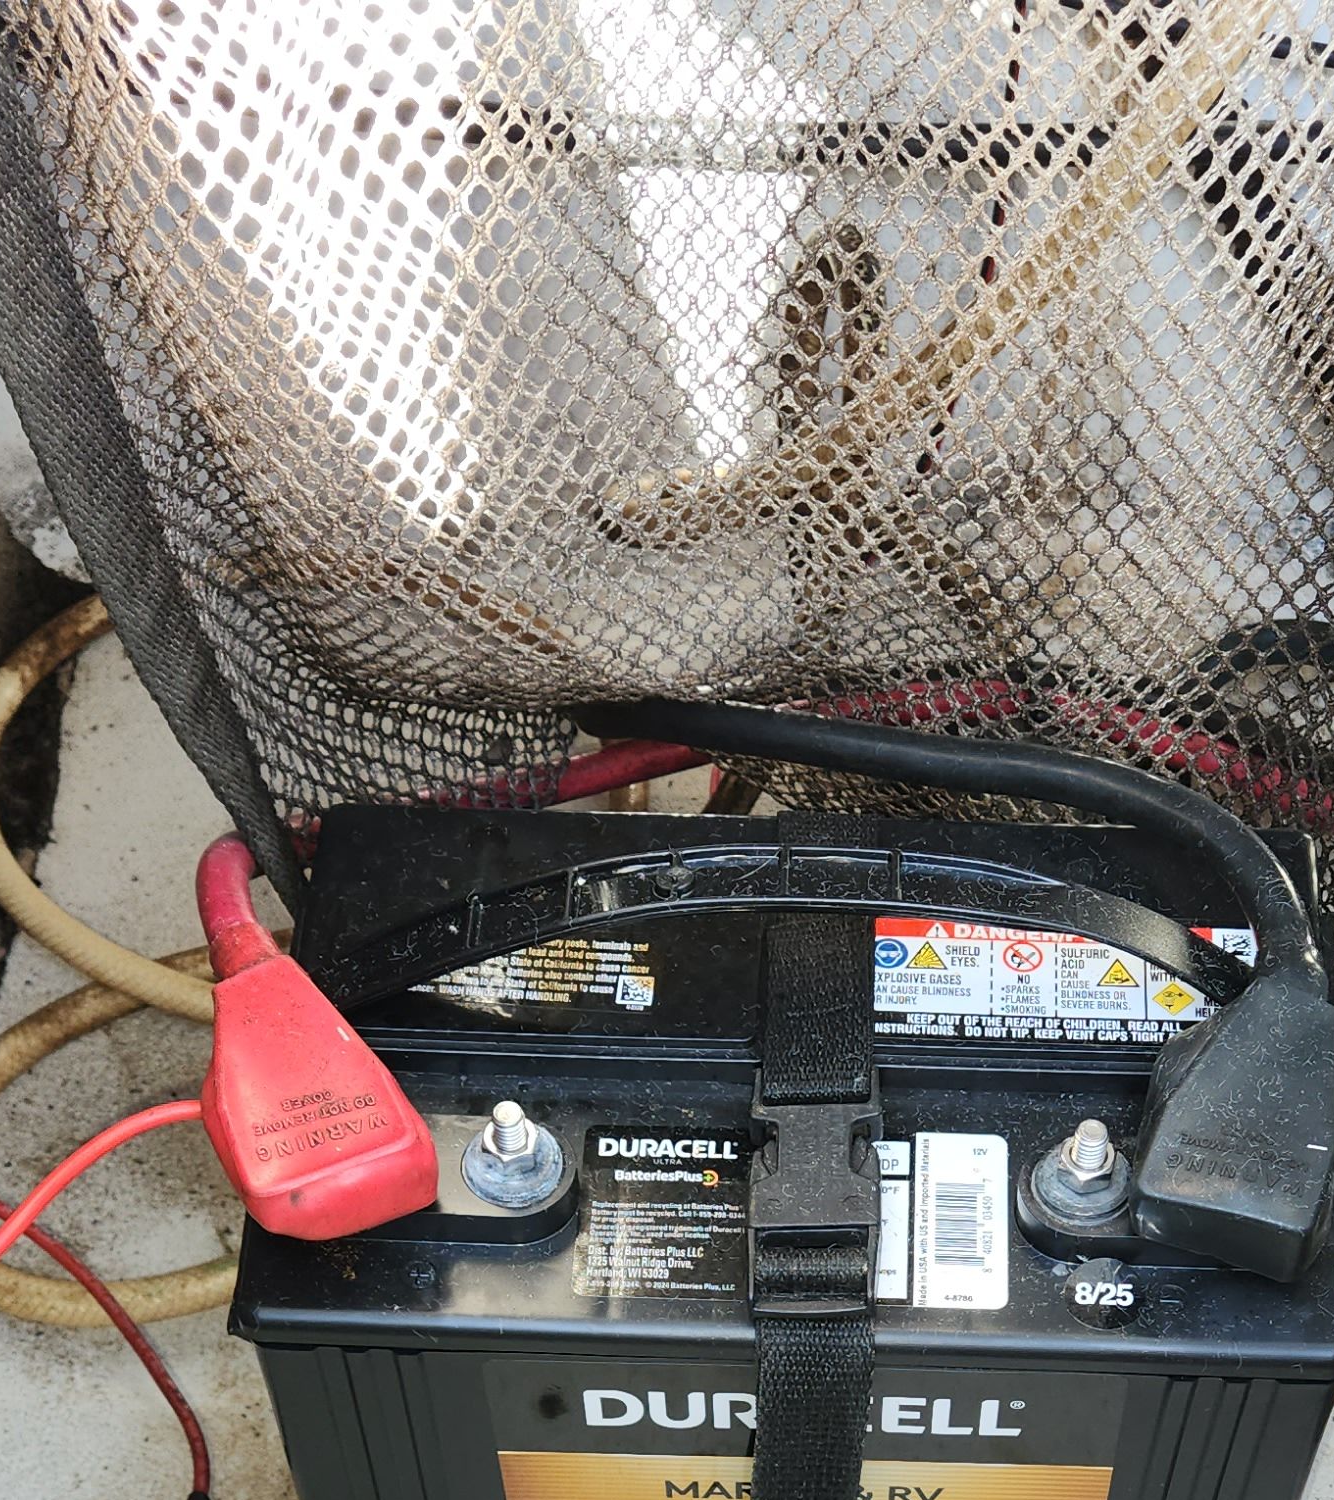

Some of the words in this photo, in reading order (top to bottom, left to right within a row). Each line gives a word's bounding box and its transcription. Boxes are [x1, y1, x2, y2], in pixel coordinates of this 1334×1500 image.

[945, 945, 980, 956] SHIELD
[1061, 948, 1110, 959] SULFURIC
[509, 956, 532, 967] State
[533, 958, 542, 967] of
[544, 958, 584, 970] California
[596, 965, 620, 973] cause
[622, 965, 650, 974] cancer
[951, 957, 979, 967] EYES.
[1061, 960, 1085, 969] ACID
[929, 974, 962, 985] GASES
[1017, 974, 1031, 984] NO
[1061, 970, 1078, 979] CAN
[875, 985, 887, 993] AN
[891, 986, 919, 995] CAUSE
[922, 987, 971, 997] BLINDNESS
[1061, 980, 1090, 989] CAUSE
[439, 984, 464, 996] WASH
[497, 987, 524, 999] AFTER
[526, 990, 571, 1003] HANDLING.
[875, 994, 882, 1004] R
[1061, 990, 1111, 999] BLINDNESS
[1113, 991, 1126, 1000] OR
[1061, 1000, 1095, 1009] SEVERE
[1097, 1001, 1131, 1010] BURNS.
[907, 1013, 936, 1024] KEEP
[937, 1015, 961, 1025] OUT
[963, 1015, 980, 1026] OF
[980, 1016, 1002, 1026] THE
[1005, 1017, 1042, 1028] REACH
[1045, 1019, 1061, 1029] OF
[1063, 1019, 1124, 1031] CHILDREN.
[1128, 1021, 1159, 1031] READ
[1161, 1021, 1182, 1032] ALL
[875, 1023, 958, 1036] NSTRUCTIONS.
[964, 1026, 981, 1037] DO
[985, 1026, 1008, 1037] NOT
[1010, 1028, 1031, 1038] TIP.
[1034, 1029, 1063, 1039] KEEP
[1065, 1030, 1095, 1040] VENT
[1097, 1031, 1128, 1042] CAPS
[1131, 1032, 1165, 1042] TIGHT
[355, 1093, 377, 1108] DO
[319, 1100, 352, 1118] NOT
[253, 1111, 318, 1136] REMOVE
[256, 1113, 389, 1161] WARNING
[598, 1137, 738, 1159] DURACELL
[973, 1148, 987, 1156] 12V
[921, 1139, 929, 1171] Materials
[653, 1158, 683, 1166] ULTRA
[920, 1173, 930, 1206] Imported
[920, 1209, 928, 1223] and
[919, 1225, 928, 1236] US
[588, 1245, 608, 1255] Dist.
[625, 1246, 665, 1257] Batteries
[667, 1246, 686, 1257] Plus
[687, 1246, 704, 1258] LLC
[919, 1238, 928, 1254] with
[588, 1256, 607, 1266] 1325
[609, 1256, 640, 1267] Walnut
[642, 1256, 667, 1268] Ridge
[668, 1258, 694, 1270] Drive,
[919, 1257, 927, 1273] USA
[628, 1267, 641, 1278] WI
[642, 1268, 669, 1279] 53029
[670, 1282, 703, 1290] Batteries
[918, 1285, 927, 1306] Made
[1074, 1282, 1134, 1306] 8/25
